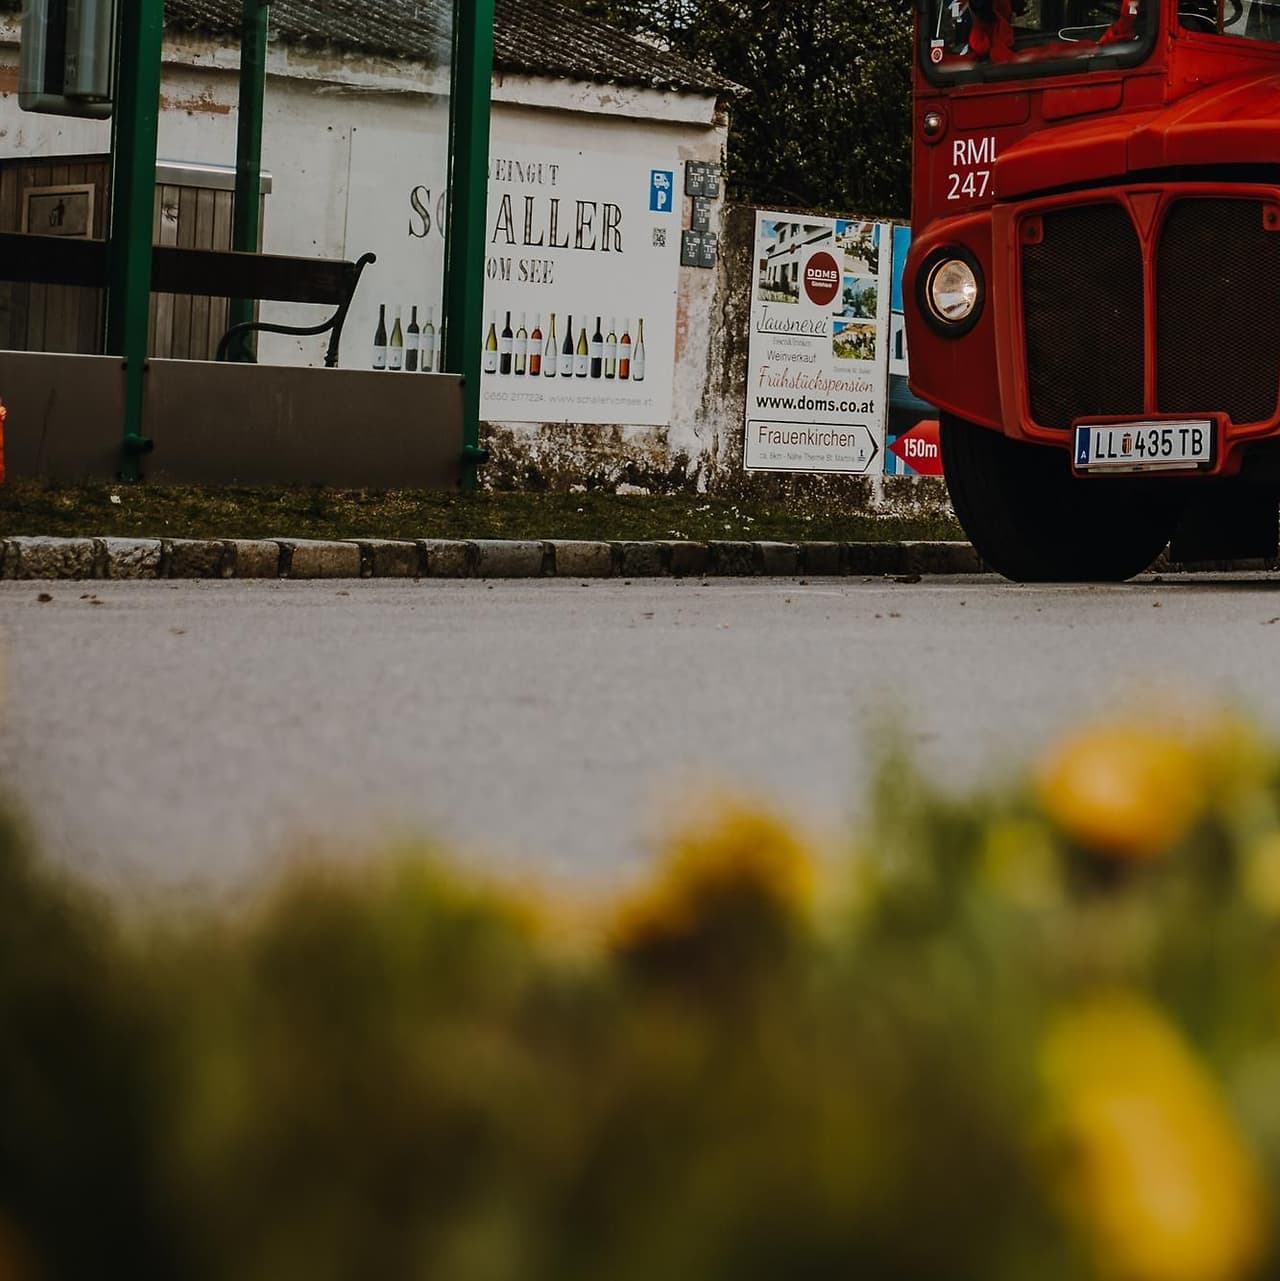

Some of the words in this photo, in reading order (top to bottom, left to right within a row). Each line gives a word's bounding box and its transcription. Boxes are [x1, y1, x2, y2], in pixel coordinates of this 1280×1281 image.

[487, 159, 560, 186] EINGUT
[946, 171, 996, 200] 247
[656, 190, 667, 210] P
[486, 257, 512, 282] OM
[518, 259, 554, 285] SEE
[807, 268, 838, 279] DOMS
[756, 305, 829, 334] Jausnerei
[767, 349, 817, 364] Weinverkauf
[759, 365, 874, 396] Frühstückspension
[756, 394, 875, 413] www.doms.co.at
[758, 425, 856, 447] Frauenkirchen
[1095, 431, 1117, 459] LL
[903, 437, 938, 458] 150m
[1080, 450, 1087, 460] A
